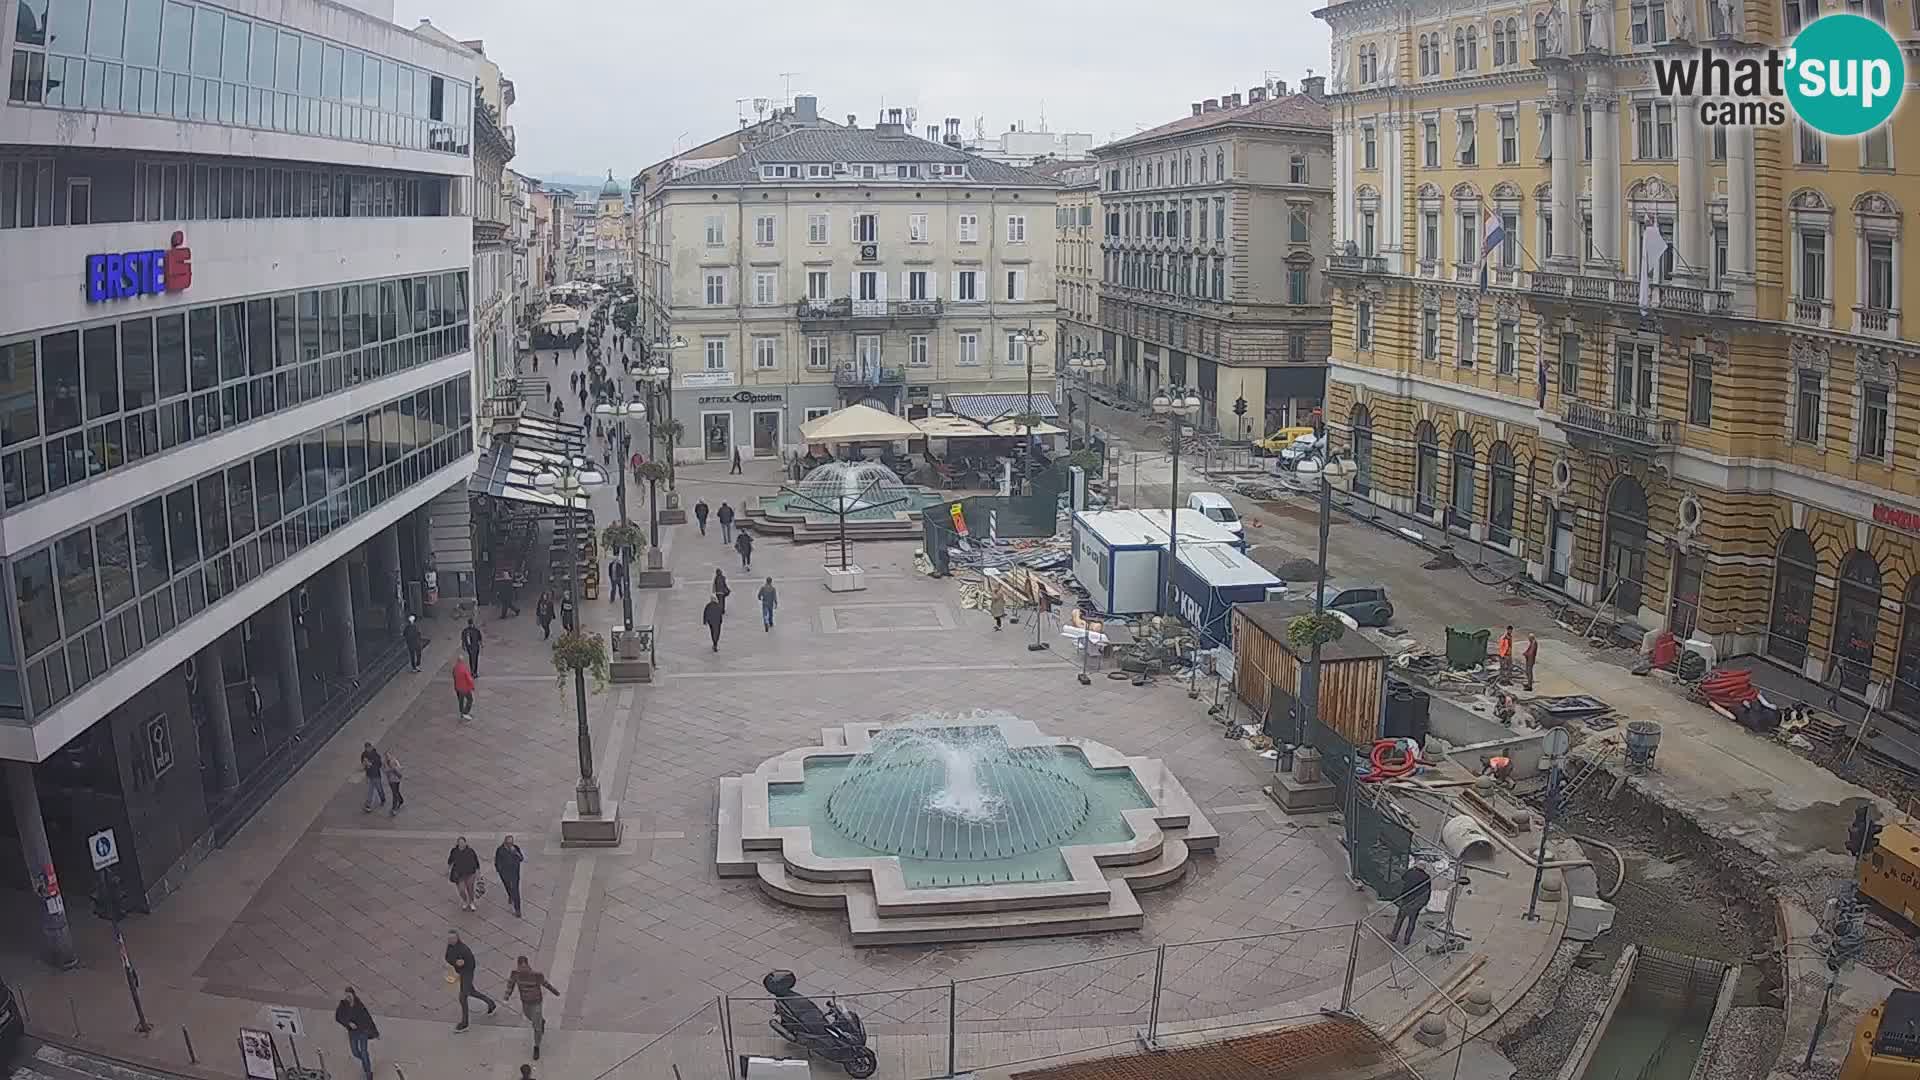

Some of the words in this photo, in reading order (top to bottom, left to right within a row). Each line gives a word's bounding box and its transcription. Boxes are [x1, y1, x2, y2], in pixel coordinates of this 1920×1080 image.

[86, 249, 165, 304] ERSTE
[698, 396, 732, 404] OPTIKA
[1180, 590, 1202, 630] KRK
